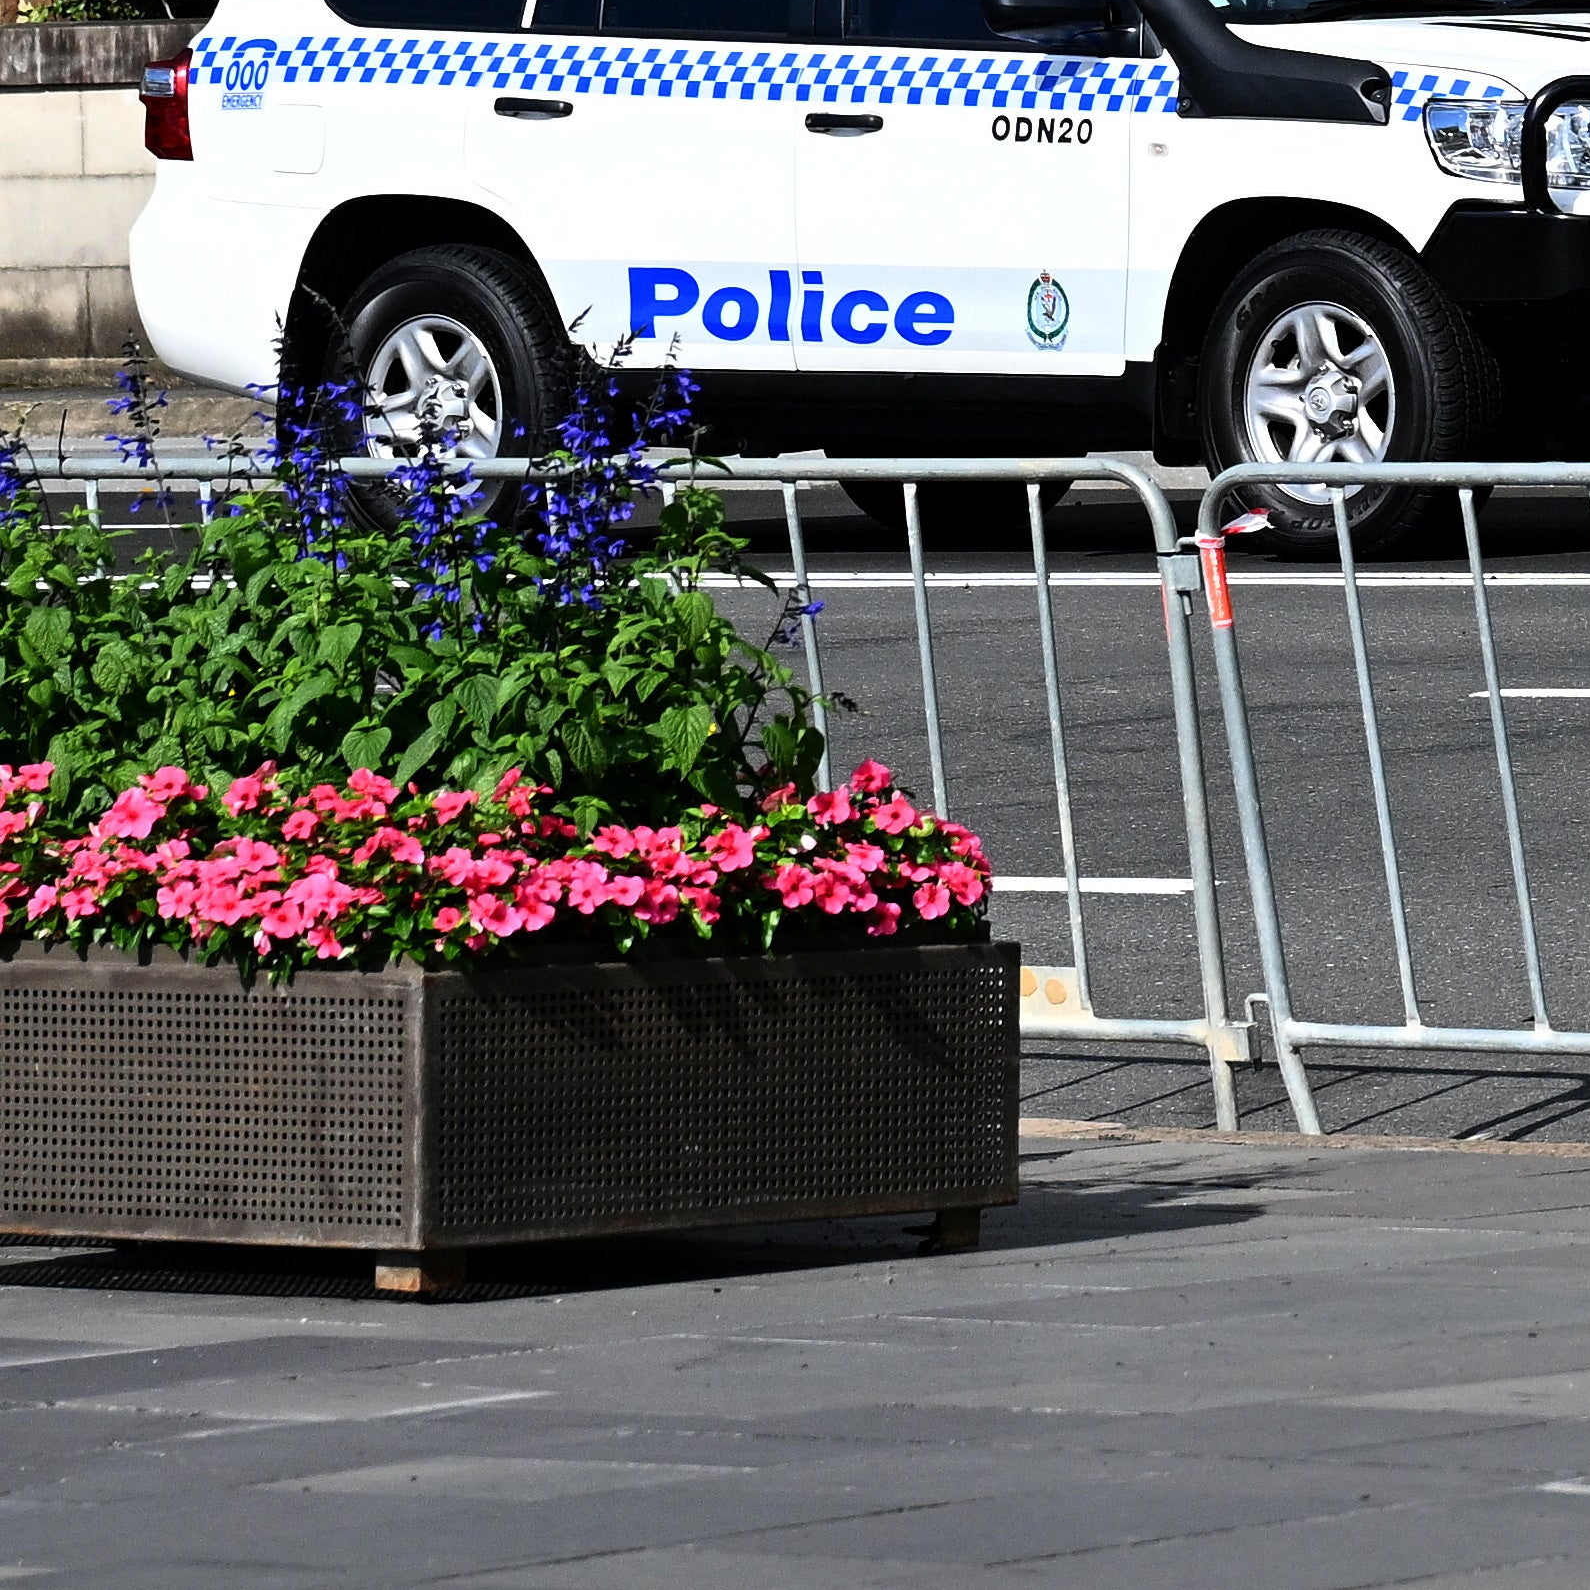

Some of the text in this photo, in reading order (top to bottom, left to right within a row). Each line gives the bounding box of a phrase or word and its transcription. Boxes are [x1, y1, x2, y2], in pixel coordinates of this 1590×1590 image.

[226, 60, 269, 91] 000
[991, 115, 1093, 145] ODN20
[628, 268, 955, 345] Police
